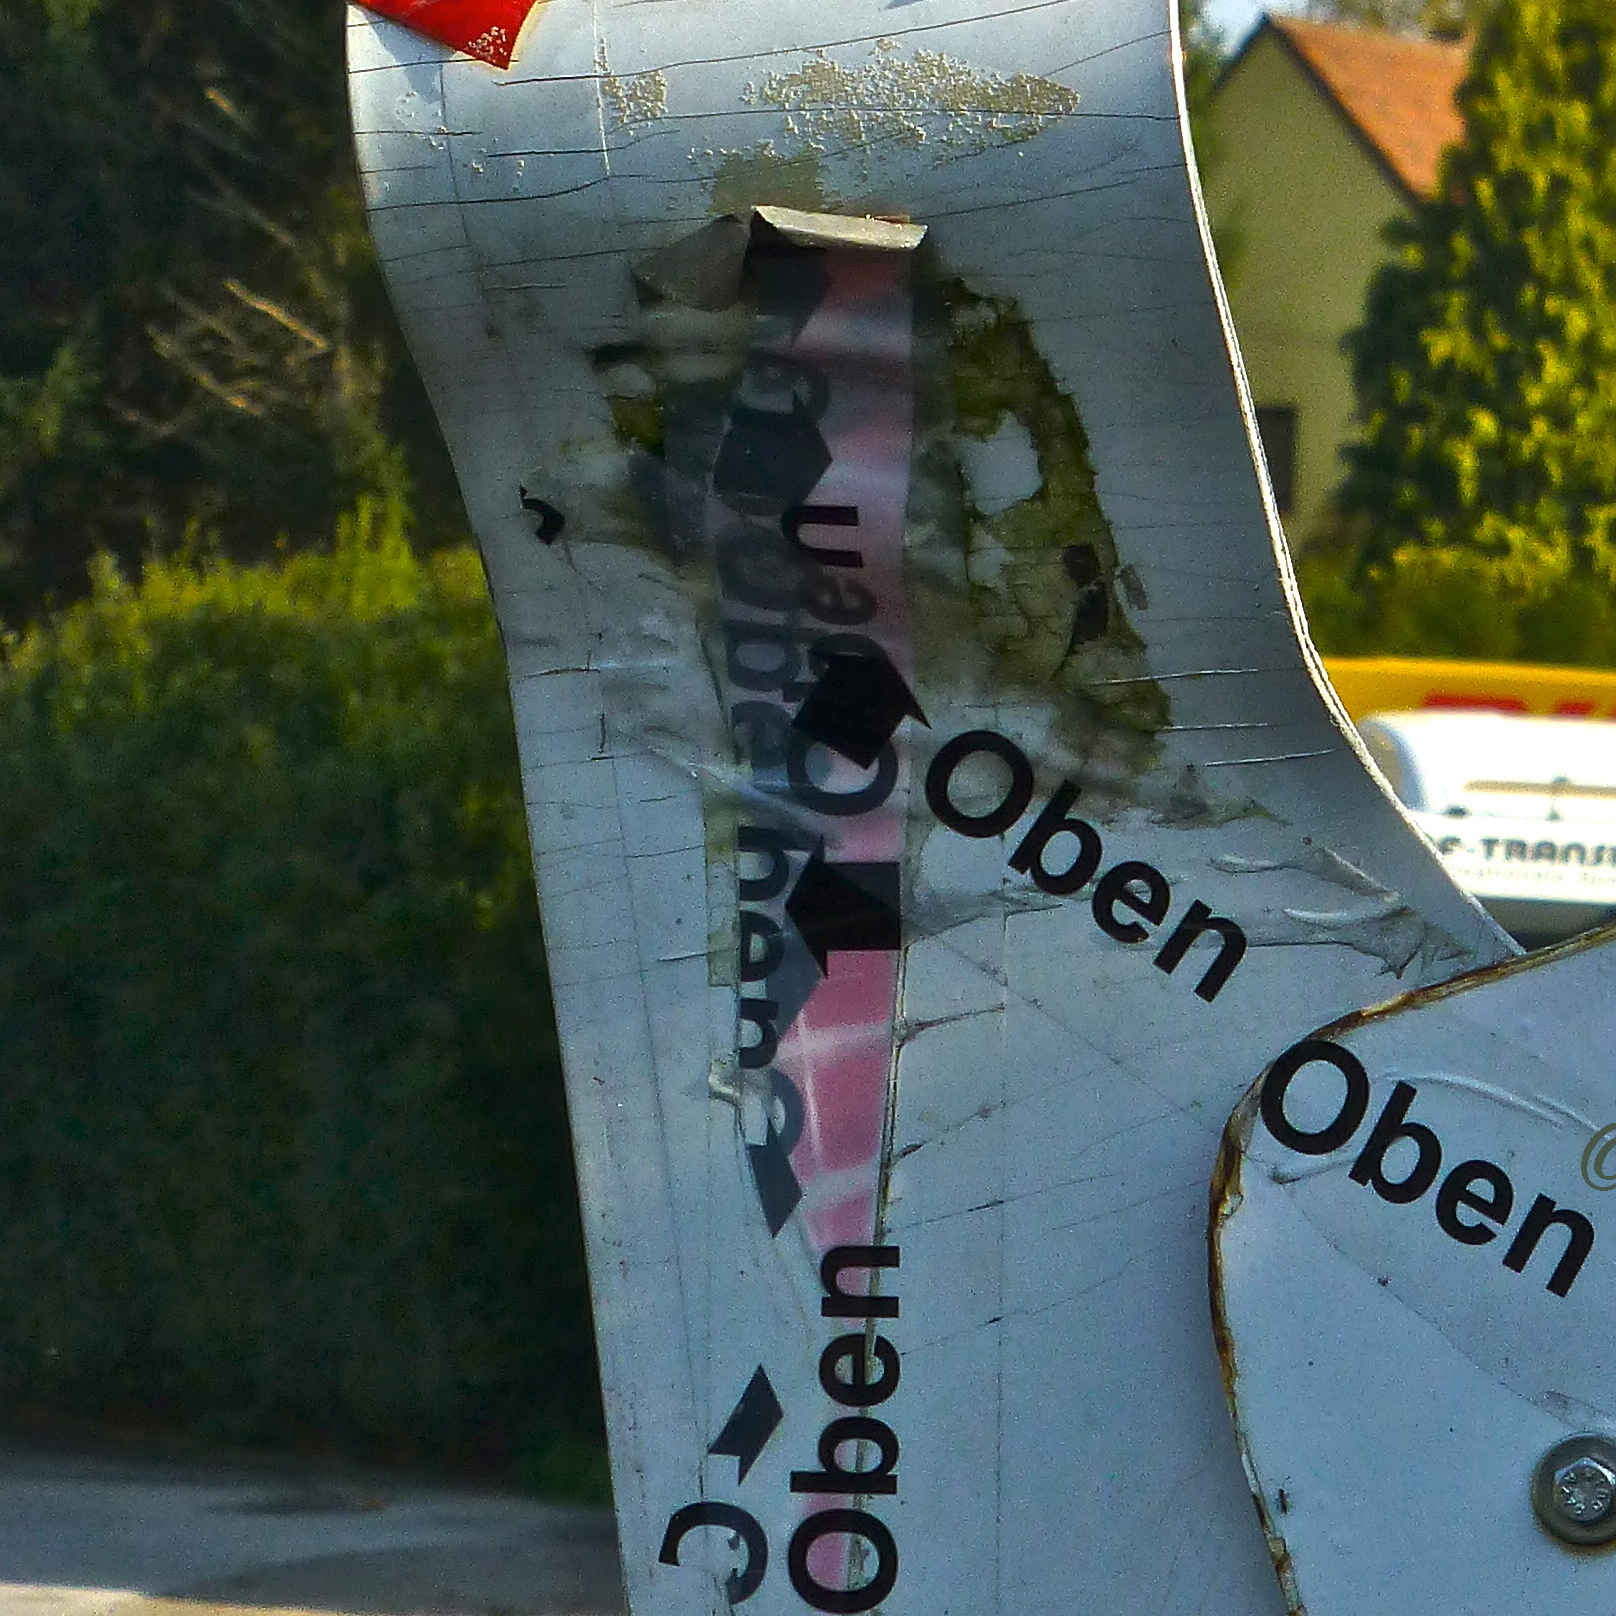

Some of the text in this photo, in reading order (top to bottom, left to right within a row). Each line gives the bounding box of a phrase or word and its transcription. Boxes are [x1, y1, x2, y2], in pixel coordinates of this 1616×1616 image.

[925, 729, 1247, 1002] Oben
[1260, 1039, 1597, 1298] Oben
[787, 1244, 901, 1615] Oben
